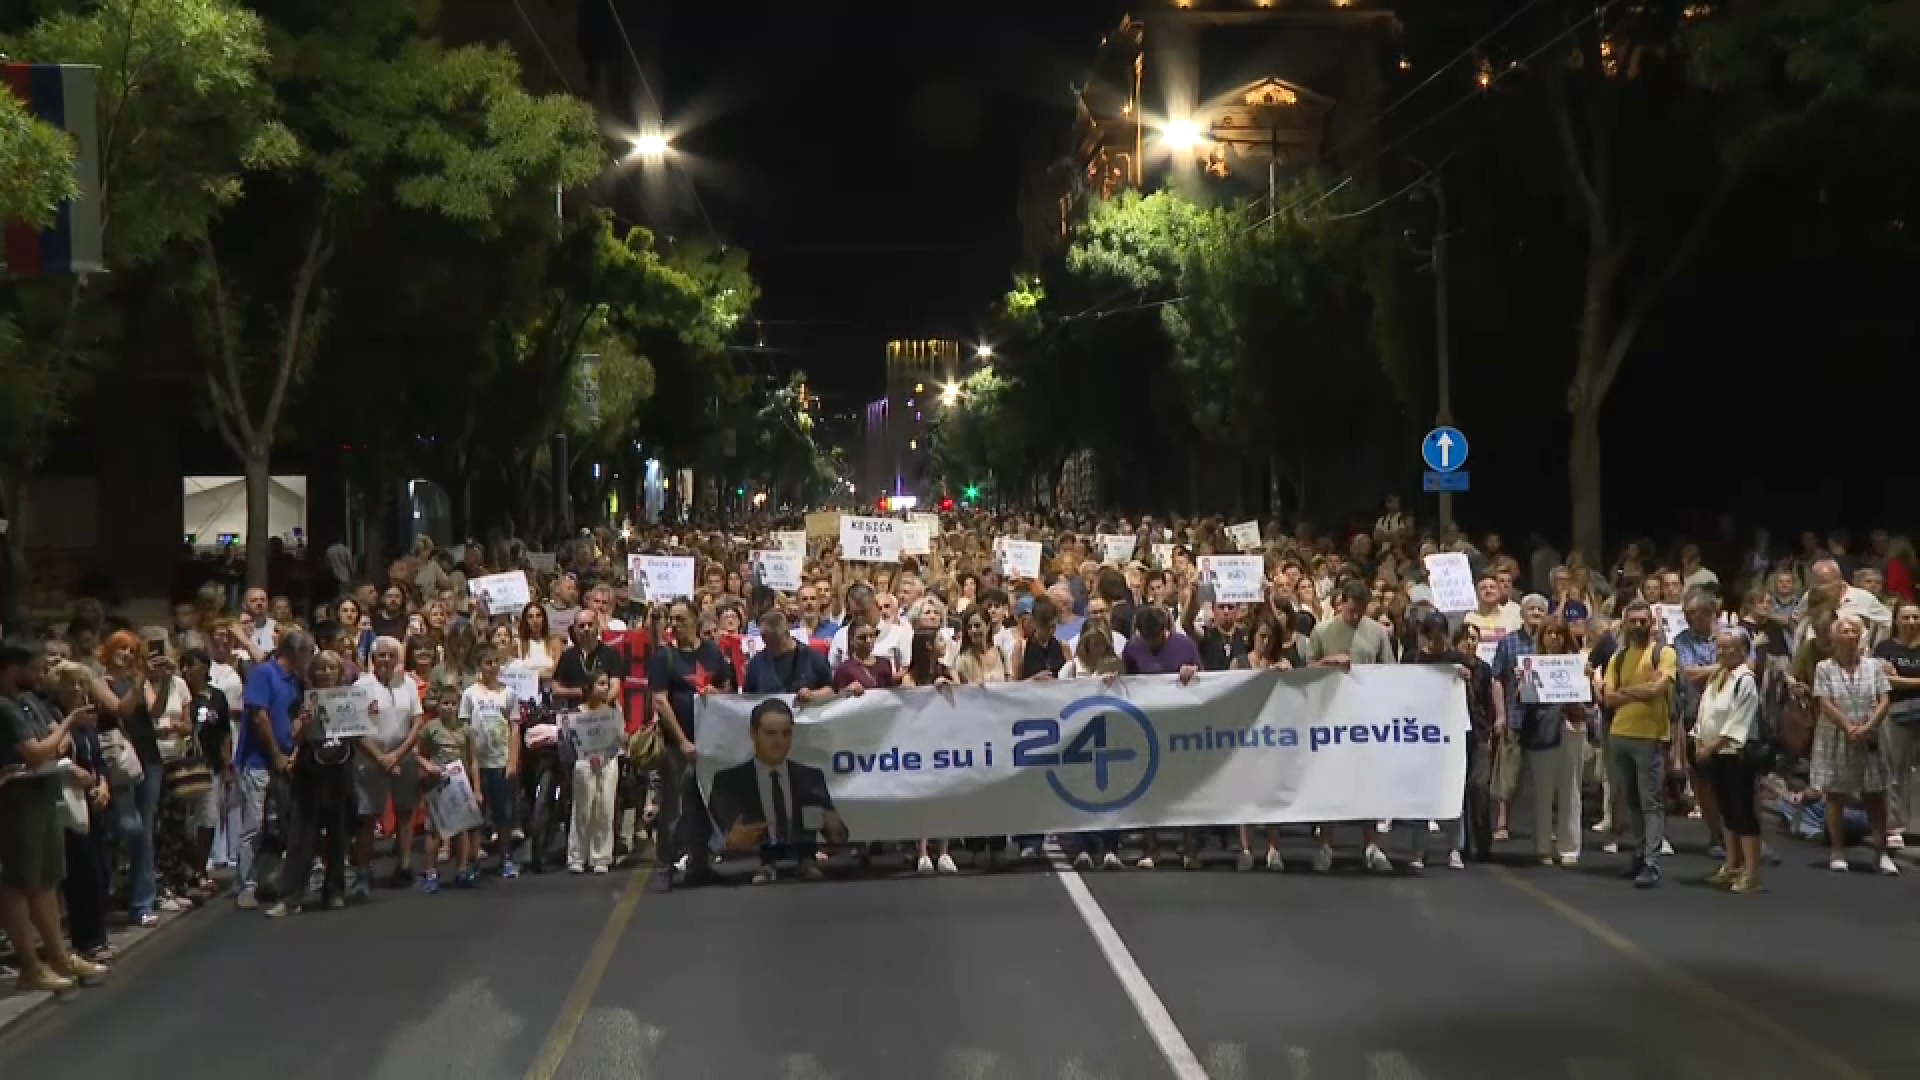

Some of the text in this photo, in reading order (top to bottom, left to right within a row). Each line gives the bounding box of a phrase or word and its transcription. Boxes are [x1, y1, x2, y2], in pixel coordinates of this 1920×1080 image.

[850, 520, 893, 533] KESIĆA
[863, 533, 879, 545] NA
[859, 545, 882, 558] RTS
[832, 747, 922, 774] Ovde
[932, 749, 974, 770] su
[983, 742, 993, 767] i
[1168, 723, 1299, 753] minuta
[1309, 717, 1451, 753] previše.
